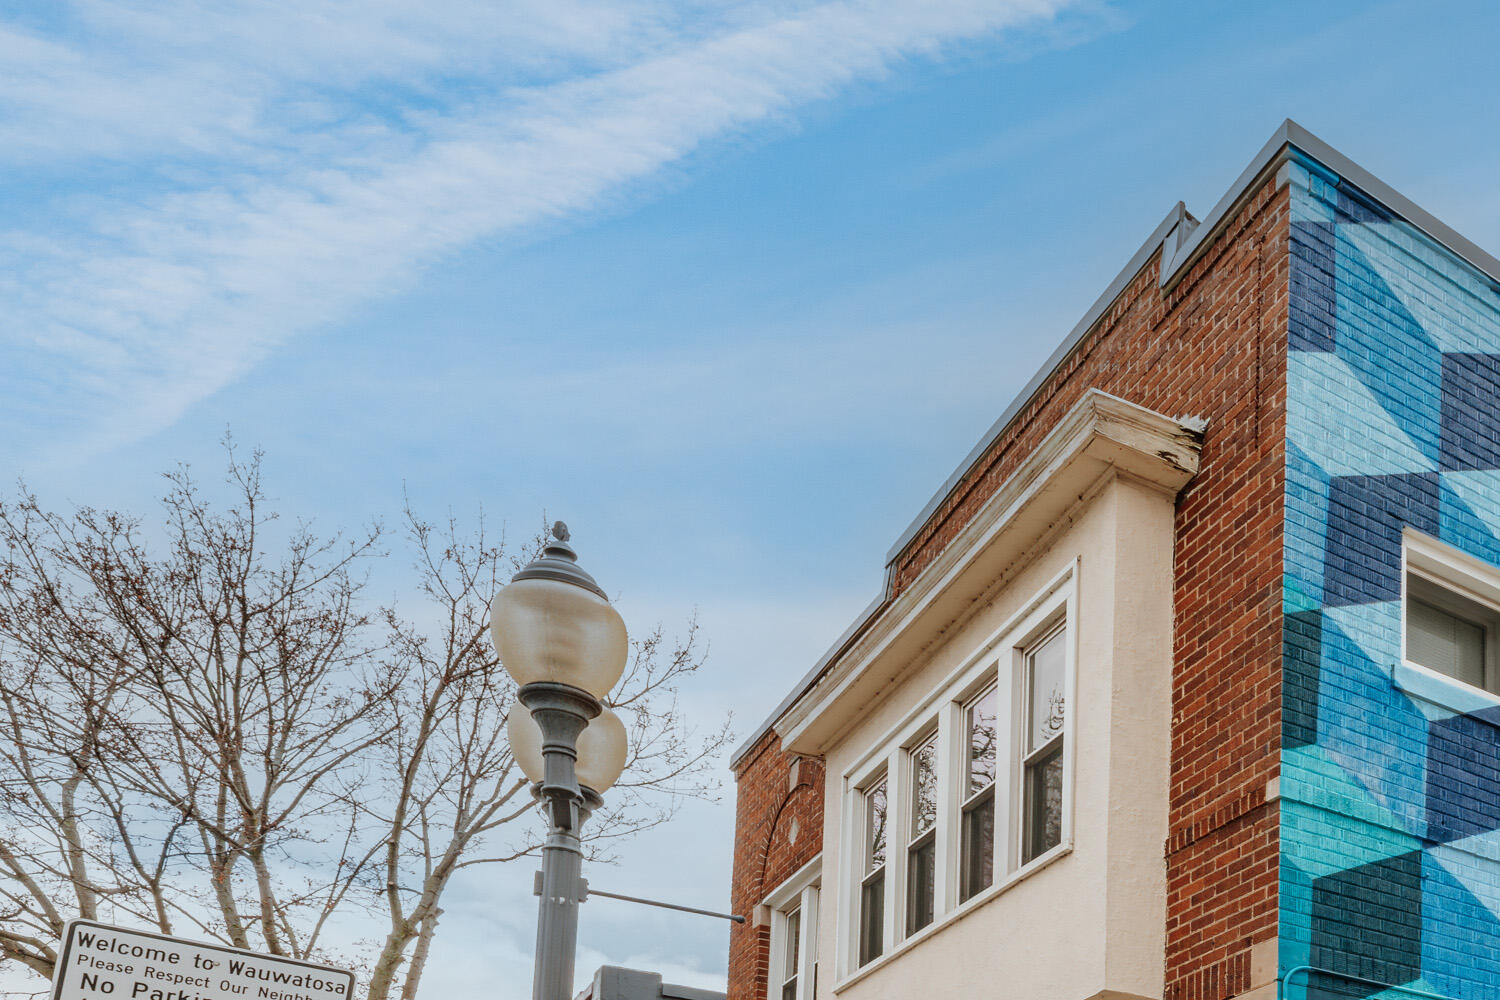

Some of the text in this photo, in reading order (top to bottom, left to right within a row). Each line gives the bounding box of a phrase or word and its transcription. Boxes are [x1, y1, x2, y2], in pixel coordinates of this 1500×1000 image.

[77, 931, 346, 995] Welcome to Wauwatosa
[77, 954, 134, 975] Please
[144, 966, 210, 989] Respect
[219, 980, 249, 995] Our
[80, 973, 115, 995] No
